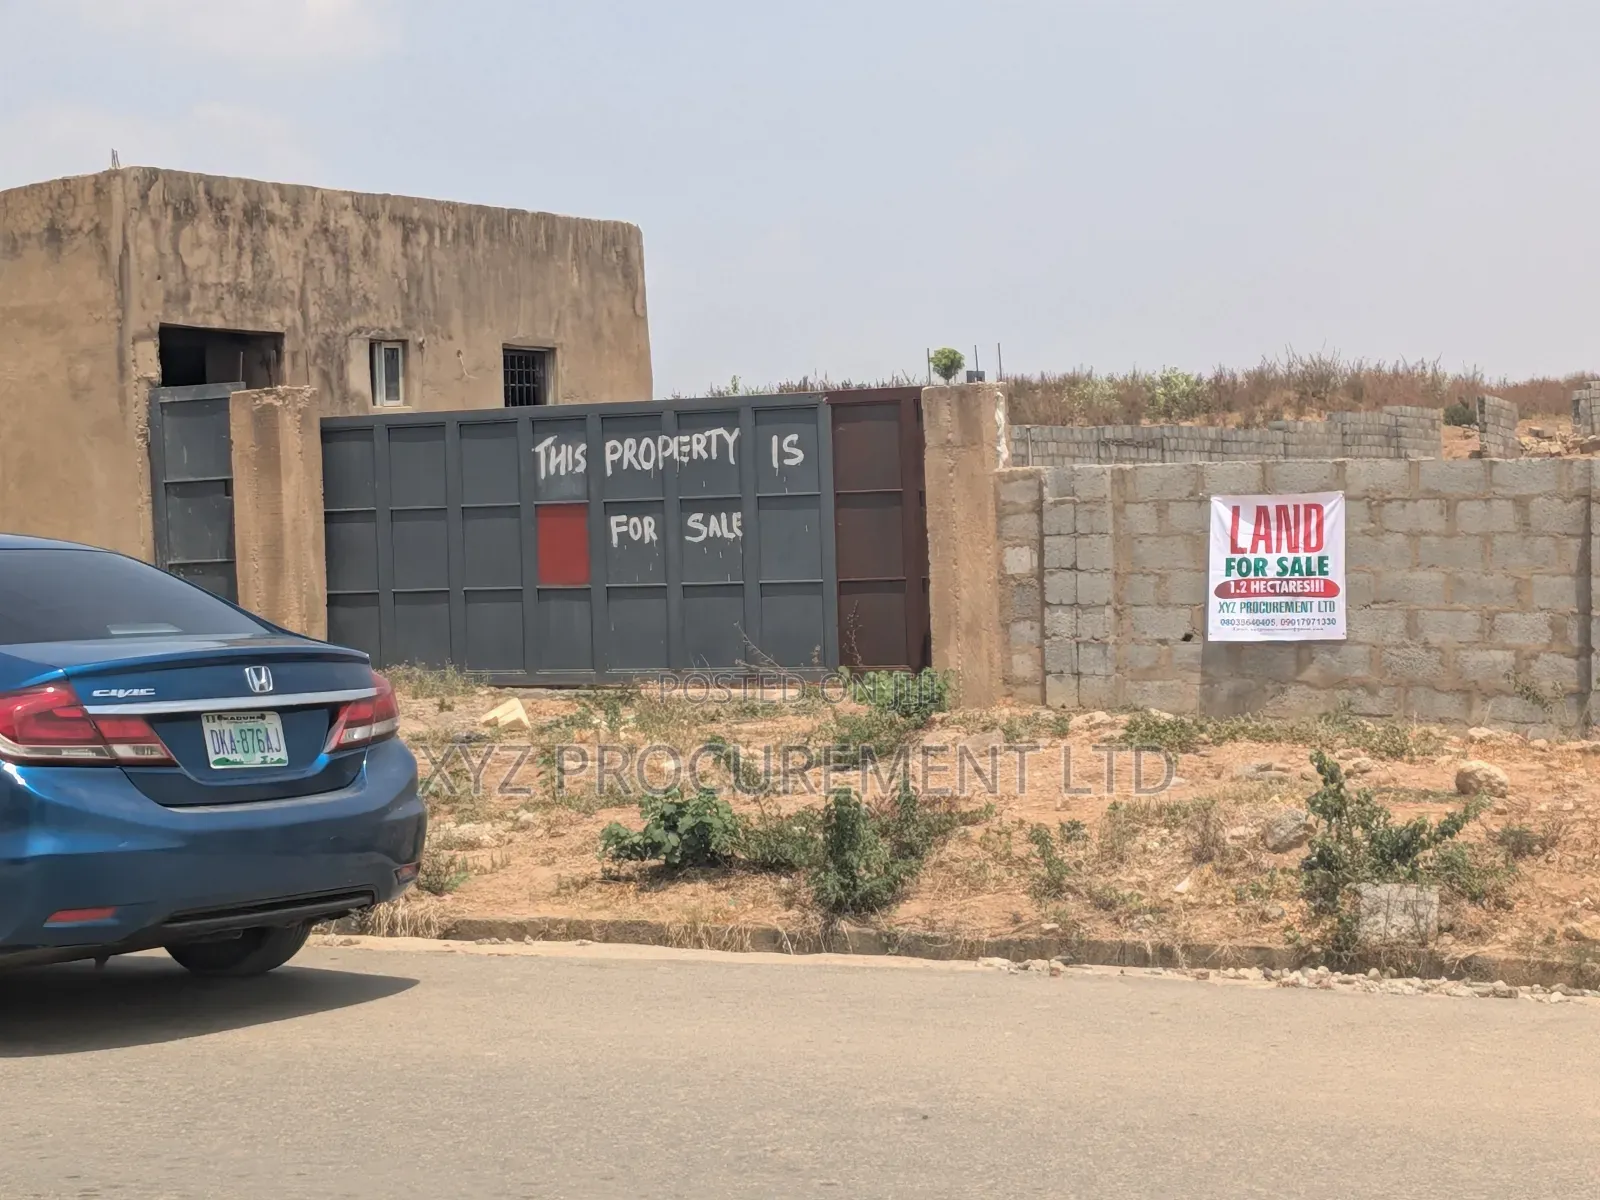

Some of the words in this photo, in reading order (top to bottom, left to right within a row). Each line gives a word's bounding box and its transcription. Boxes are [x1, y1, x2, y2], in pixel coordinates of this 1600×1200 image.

[532, 434, 588, 480] THIS
[604, 427, 740, 477] PROPERTY
[772, 433, 804, 472] IS
[610, 515, 658, 548] FOR
[685, 511, 743, 543] SALE
[1230, 503, 1324, 555] LAND
[1225, 557, 1268, 578] FOR
[1276, 556, 1329, 577] SALE
[1230, 581, 1247, 593] 1.2
[1250, 580, 1324, 593] HECTARES!!!
[1218, 601, 1236, 614] XYZ
[1240, 600, 1314, 614] PROCUREMENT
[1318, 600, 1336, 613] LTD
[92, 688, 156, 698] CIVIC
[209, 727, 282, 755] DKA-876AJ
